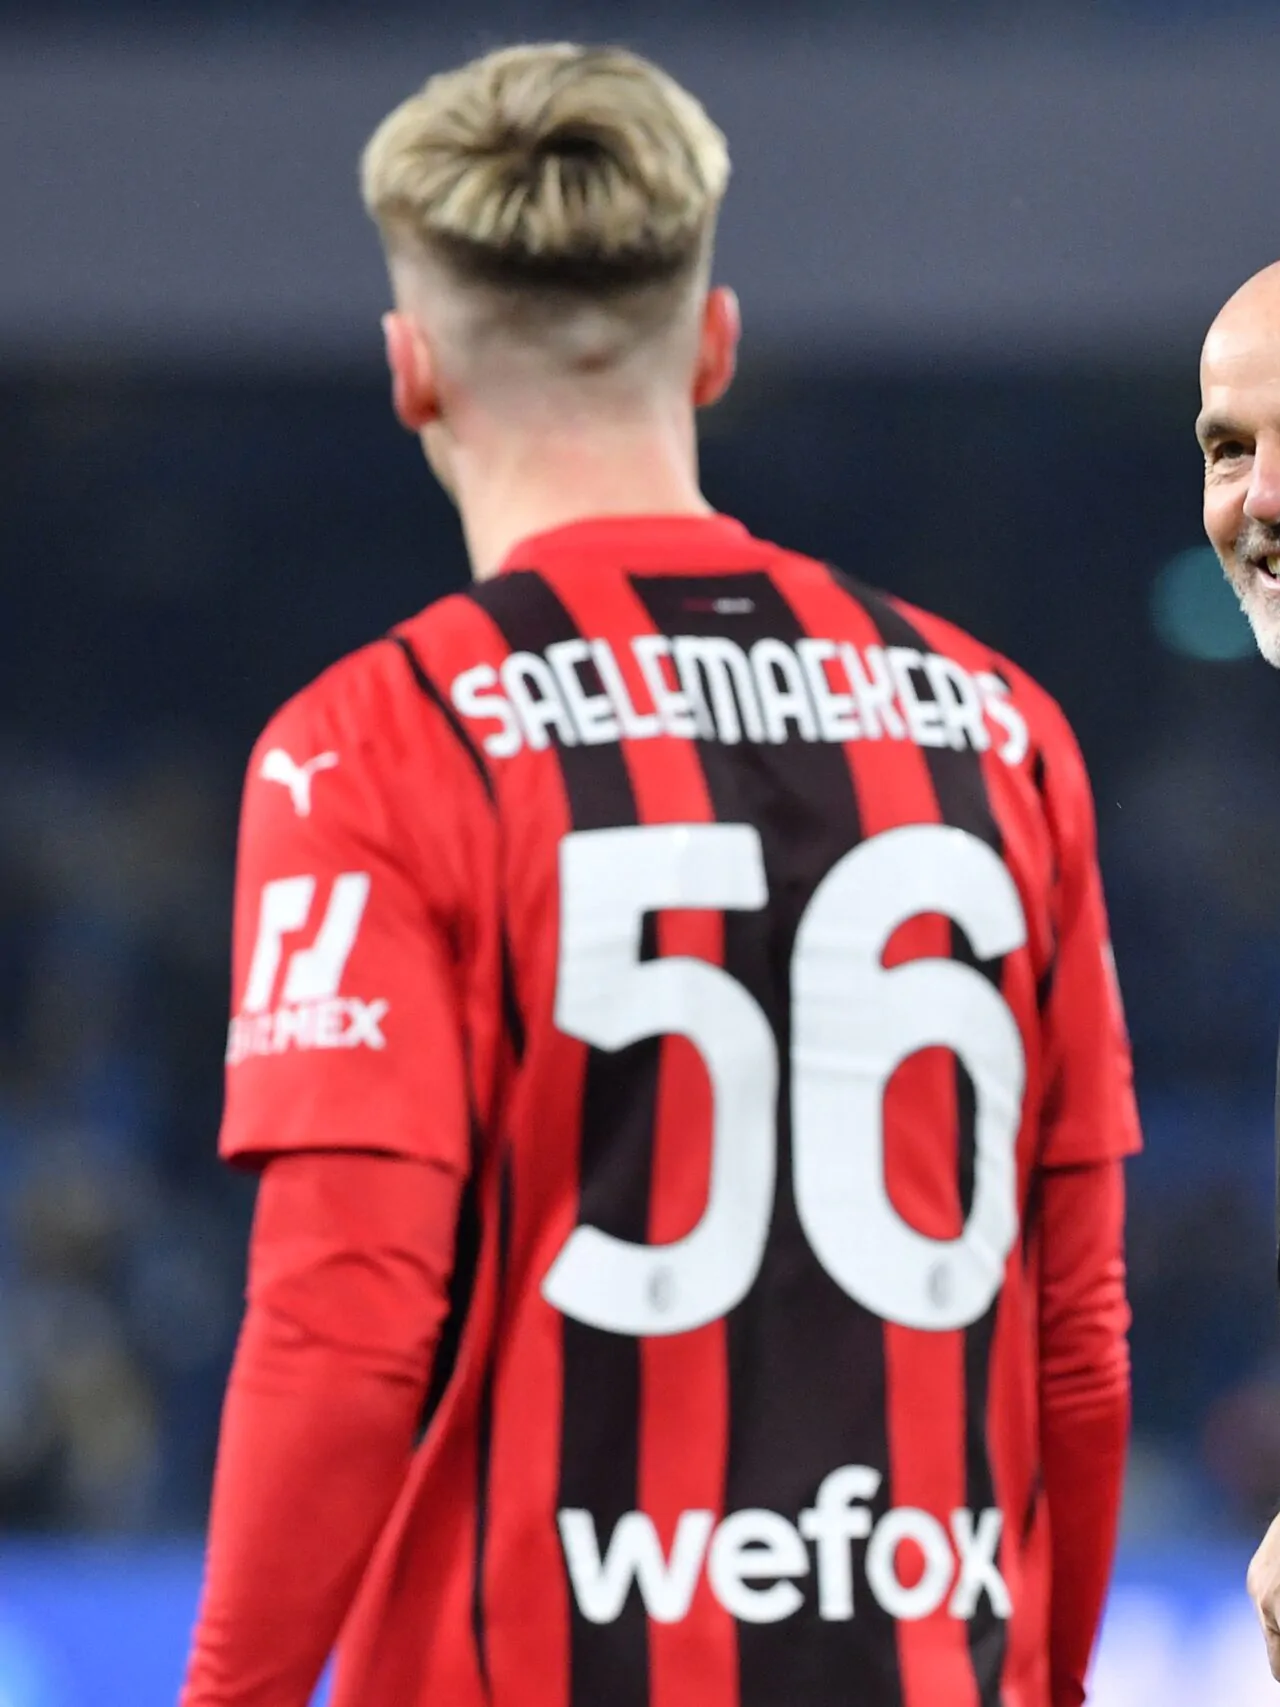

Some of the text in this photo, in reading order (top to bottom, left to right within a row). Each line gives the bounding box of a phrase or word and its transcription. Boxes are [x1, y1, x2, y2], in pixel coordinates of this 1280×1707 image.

[451, 635, 1029, 765] SAELEMAEKERS
[540, 822, 1027, 1336] 56
[557, 1464, 1013, 1624] wefox
